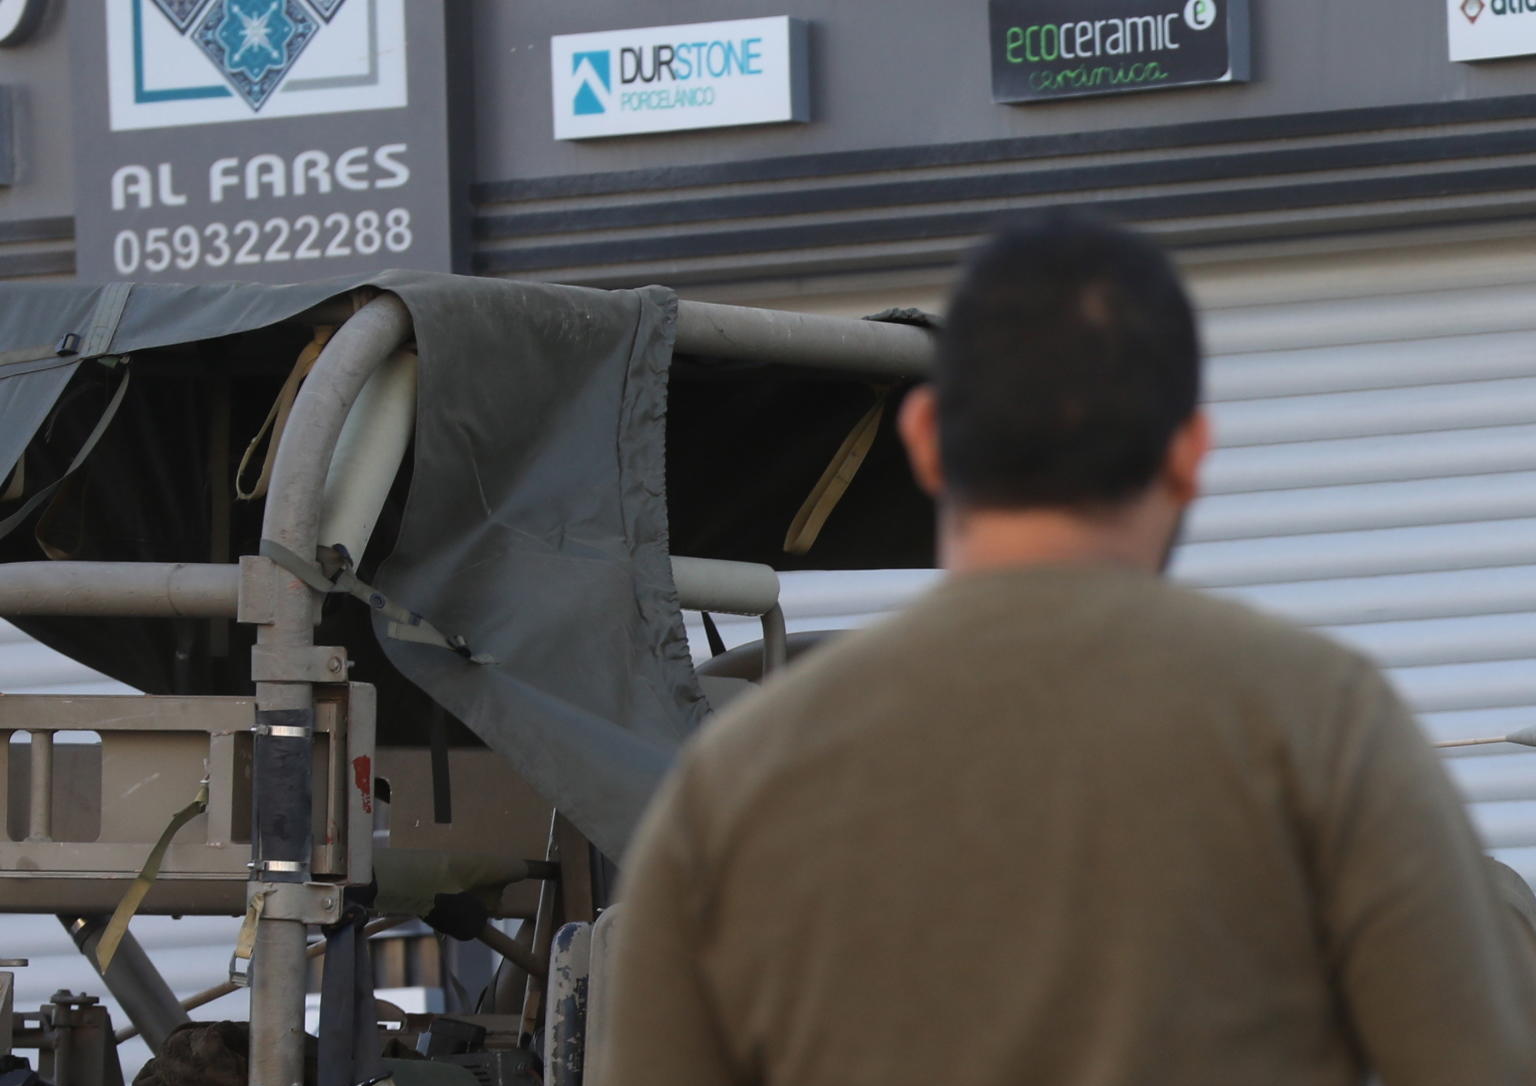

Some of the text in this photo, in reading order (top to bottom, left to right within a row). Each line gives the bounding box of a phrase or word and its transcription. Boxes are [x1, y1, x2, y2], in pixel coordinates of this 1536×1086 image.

[619, 37, 763, 84] DURSTONE
[1006, 13, 1180, 63] ecoceramic
[111, 143, 411, 210] AL FARES
[113, 207, 413, 275] 0593222288
